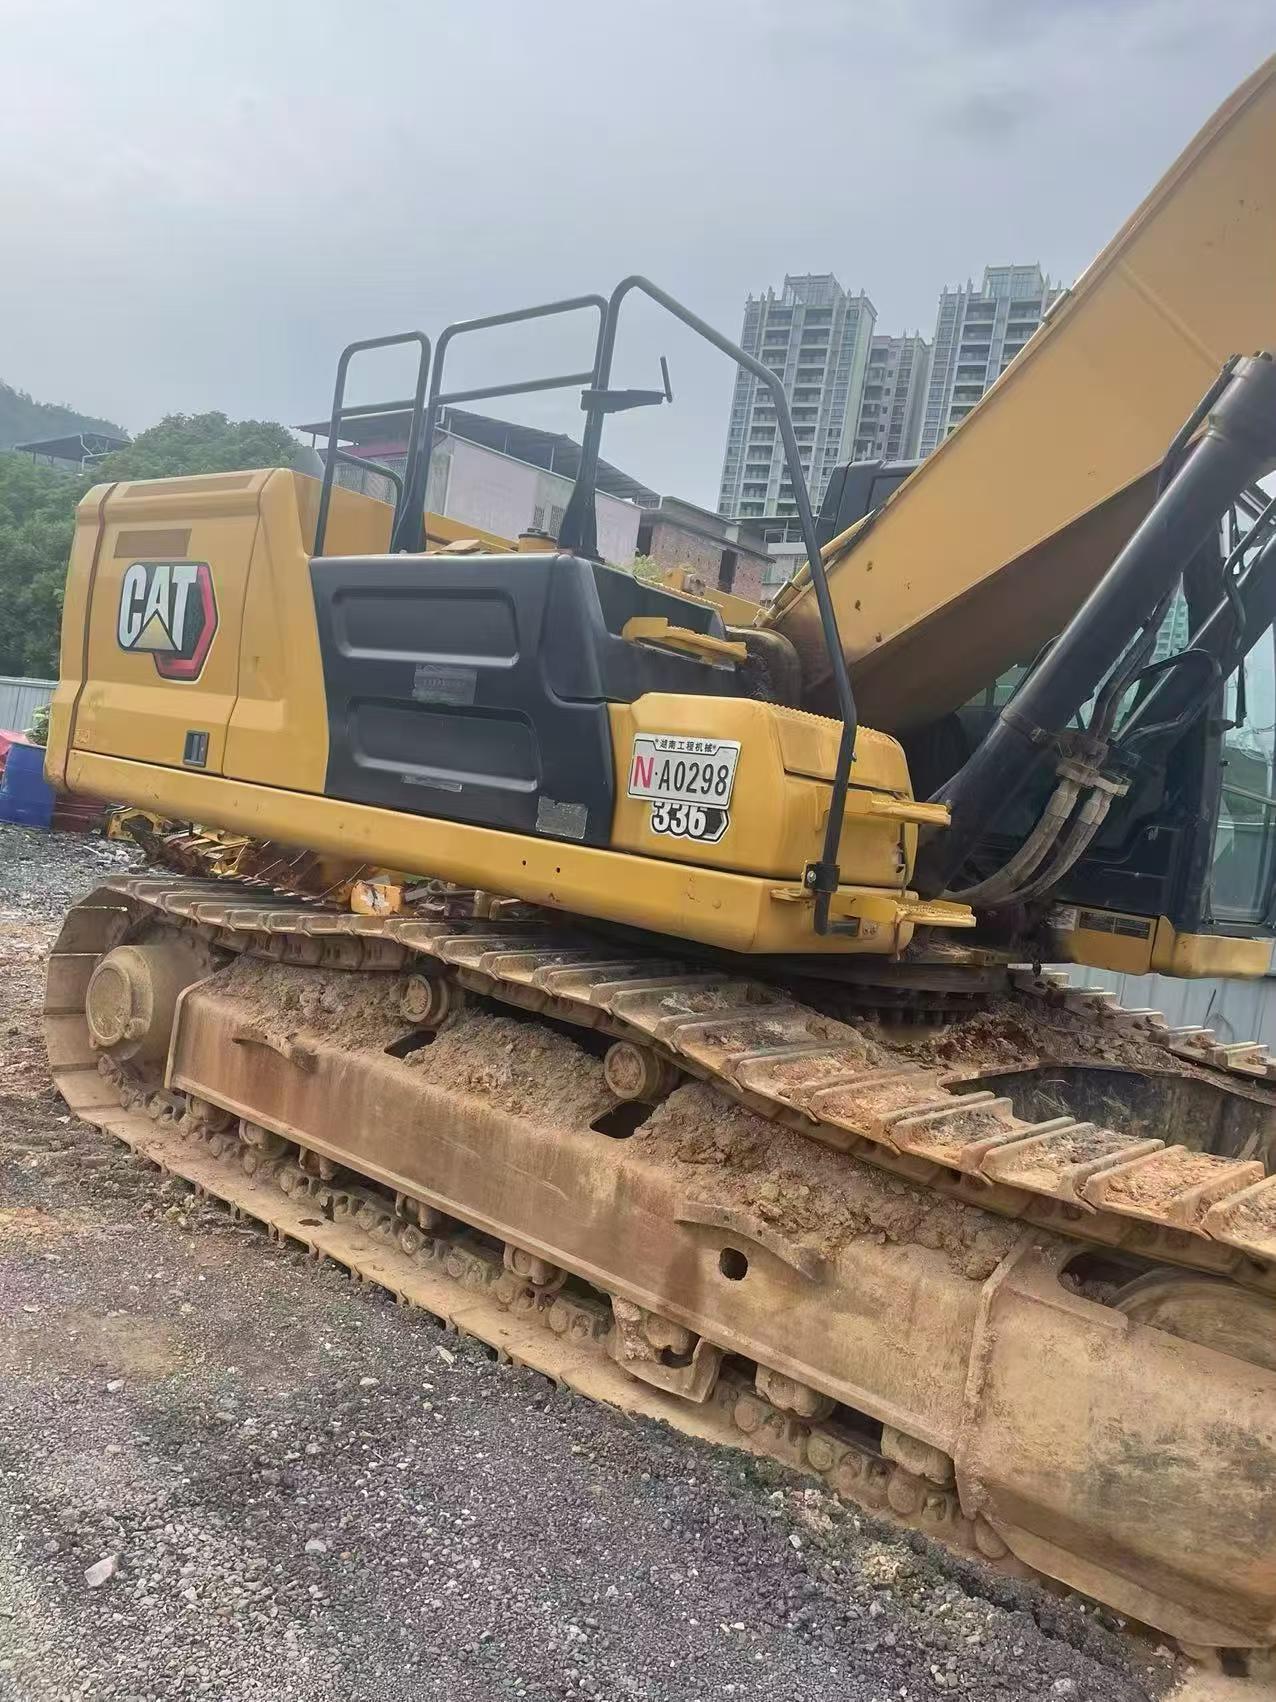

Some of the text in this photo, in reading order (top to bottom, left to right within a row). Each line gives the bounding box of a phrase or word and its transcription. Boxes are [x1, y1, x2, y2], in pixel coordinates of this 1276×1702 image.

[119, 564, 198, 651] CAT
[659, 739, 714, 753] 湖南工程机械
[652, 801, 708, 837] 336
